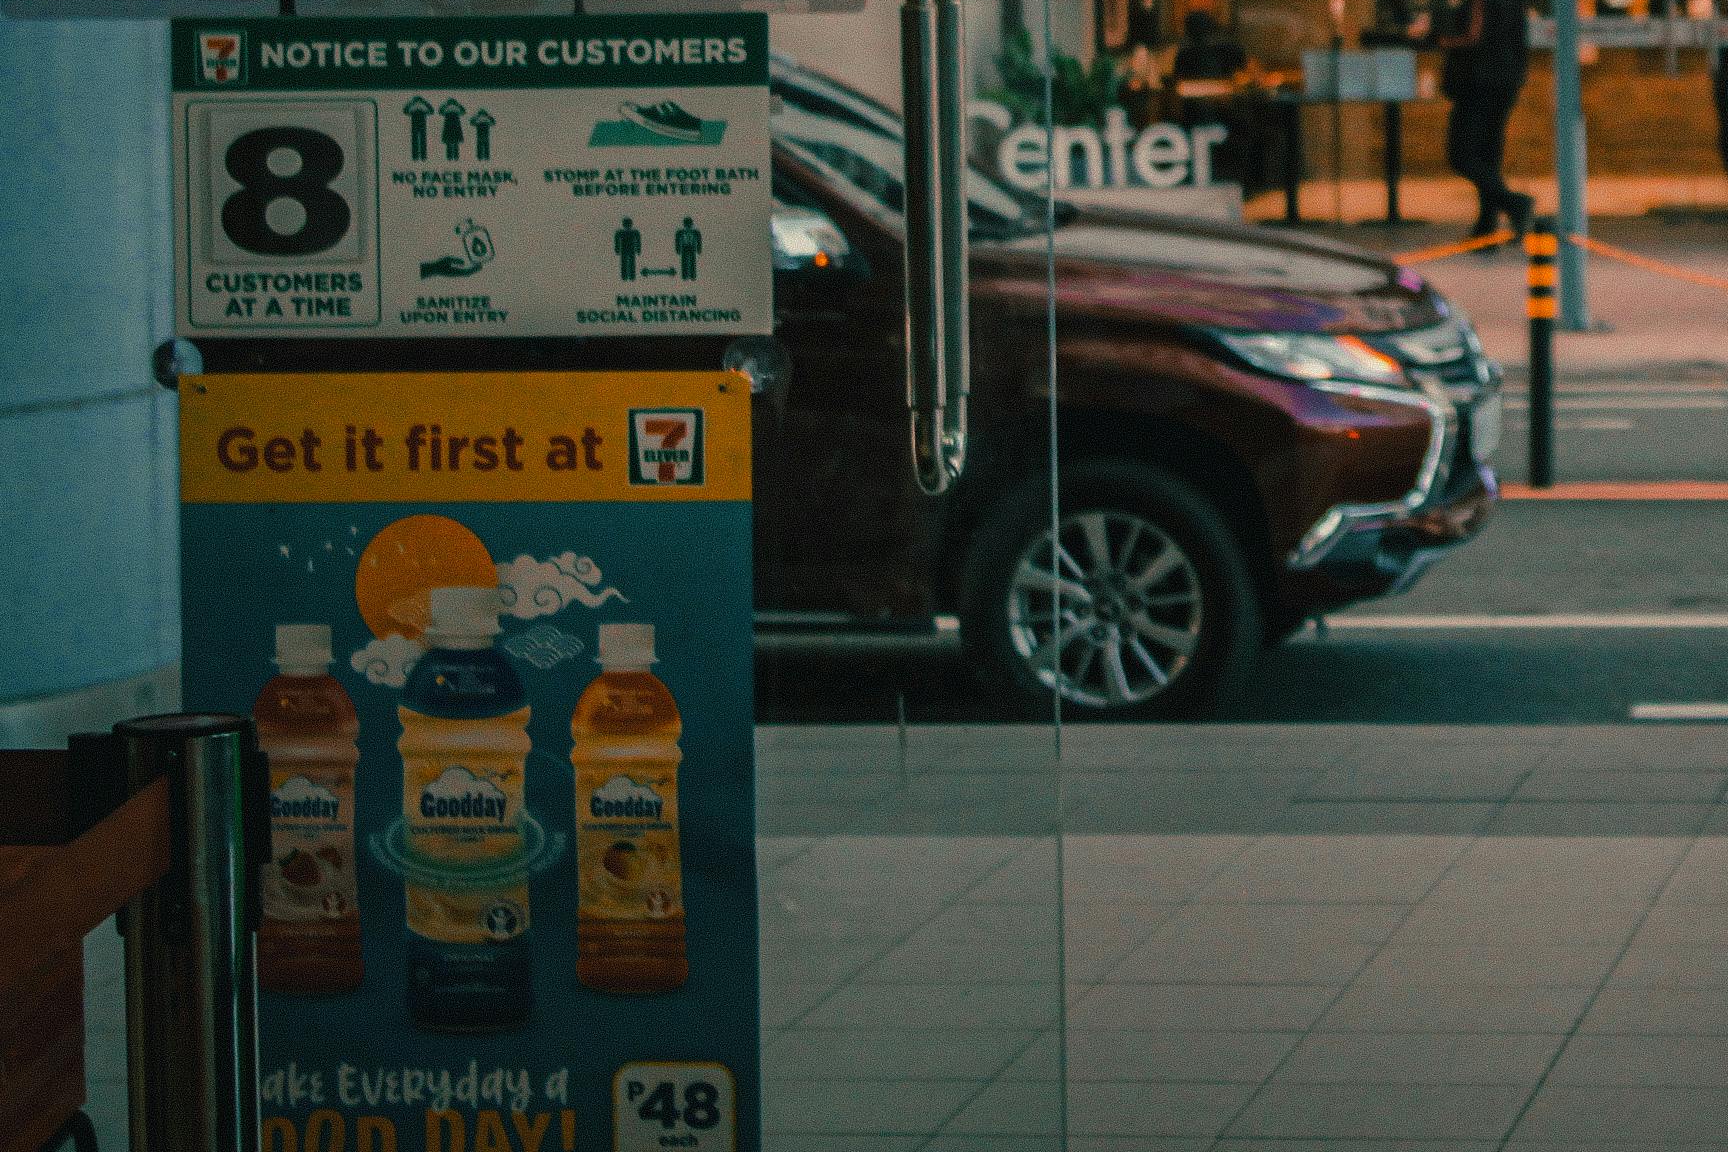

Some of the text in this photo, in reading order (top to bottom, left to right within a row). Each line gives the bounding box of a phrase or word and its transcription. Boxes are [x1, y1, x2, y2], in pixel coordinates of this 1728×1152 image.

[260, 42, 389, 68] NOTICE
[400, 41, 443, 67] TO
[454, 40, 527, 66] OUR
[537, 38, 748, 65] CUSTOMERS
[392, 171, 417, 184] NO
[422, 170, 462, 184] FACE
[544, 167, 760, 183] STOMP AT THE FOOT BATH
[220, 125, 351, 257] 8
[413, 186, 498, 198] NO ENTRY
[572, 182, 732, 198] BEFORE ENTERING
[205, 272, 363, 293] CUSTOMERS
[224, 297, 352, 318] AT A TIME
[416, 296, 491, 309] SANITIZE
[616, 295, 697, 307] MAINTAIN
[400, 310, 509, 323] UPON ENTRY
[576, 309, 742, 324] SOCIAL DISTANCING
[217, 424, 604, 474] Get it first at
[420, 792, 507, 823] Goodday
[591, 795, 663, 821] Goodday
[260, 1061, 325, 1108] ake
[545, 1066, 569, 1105] a
[262, 1109, 398, 1152] OOD
[659, 1134, 699, 1148] each
